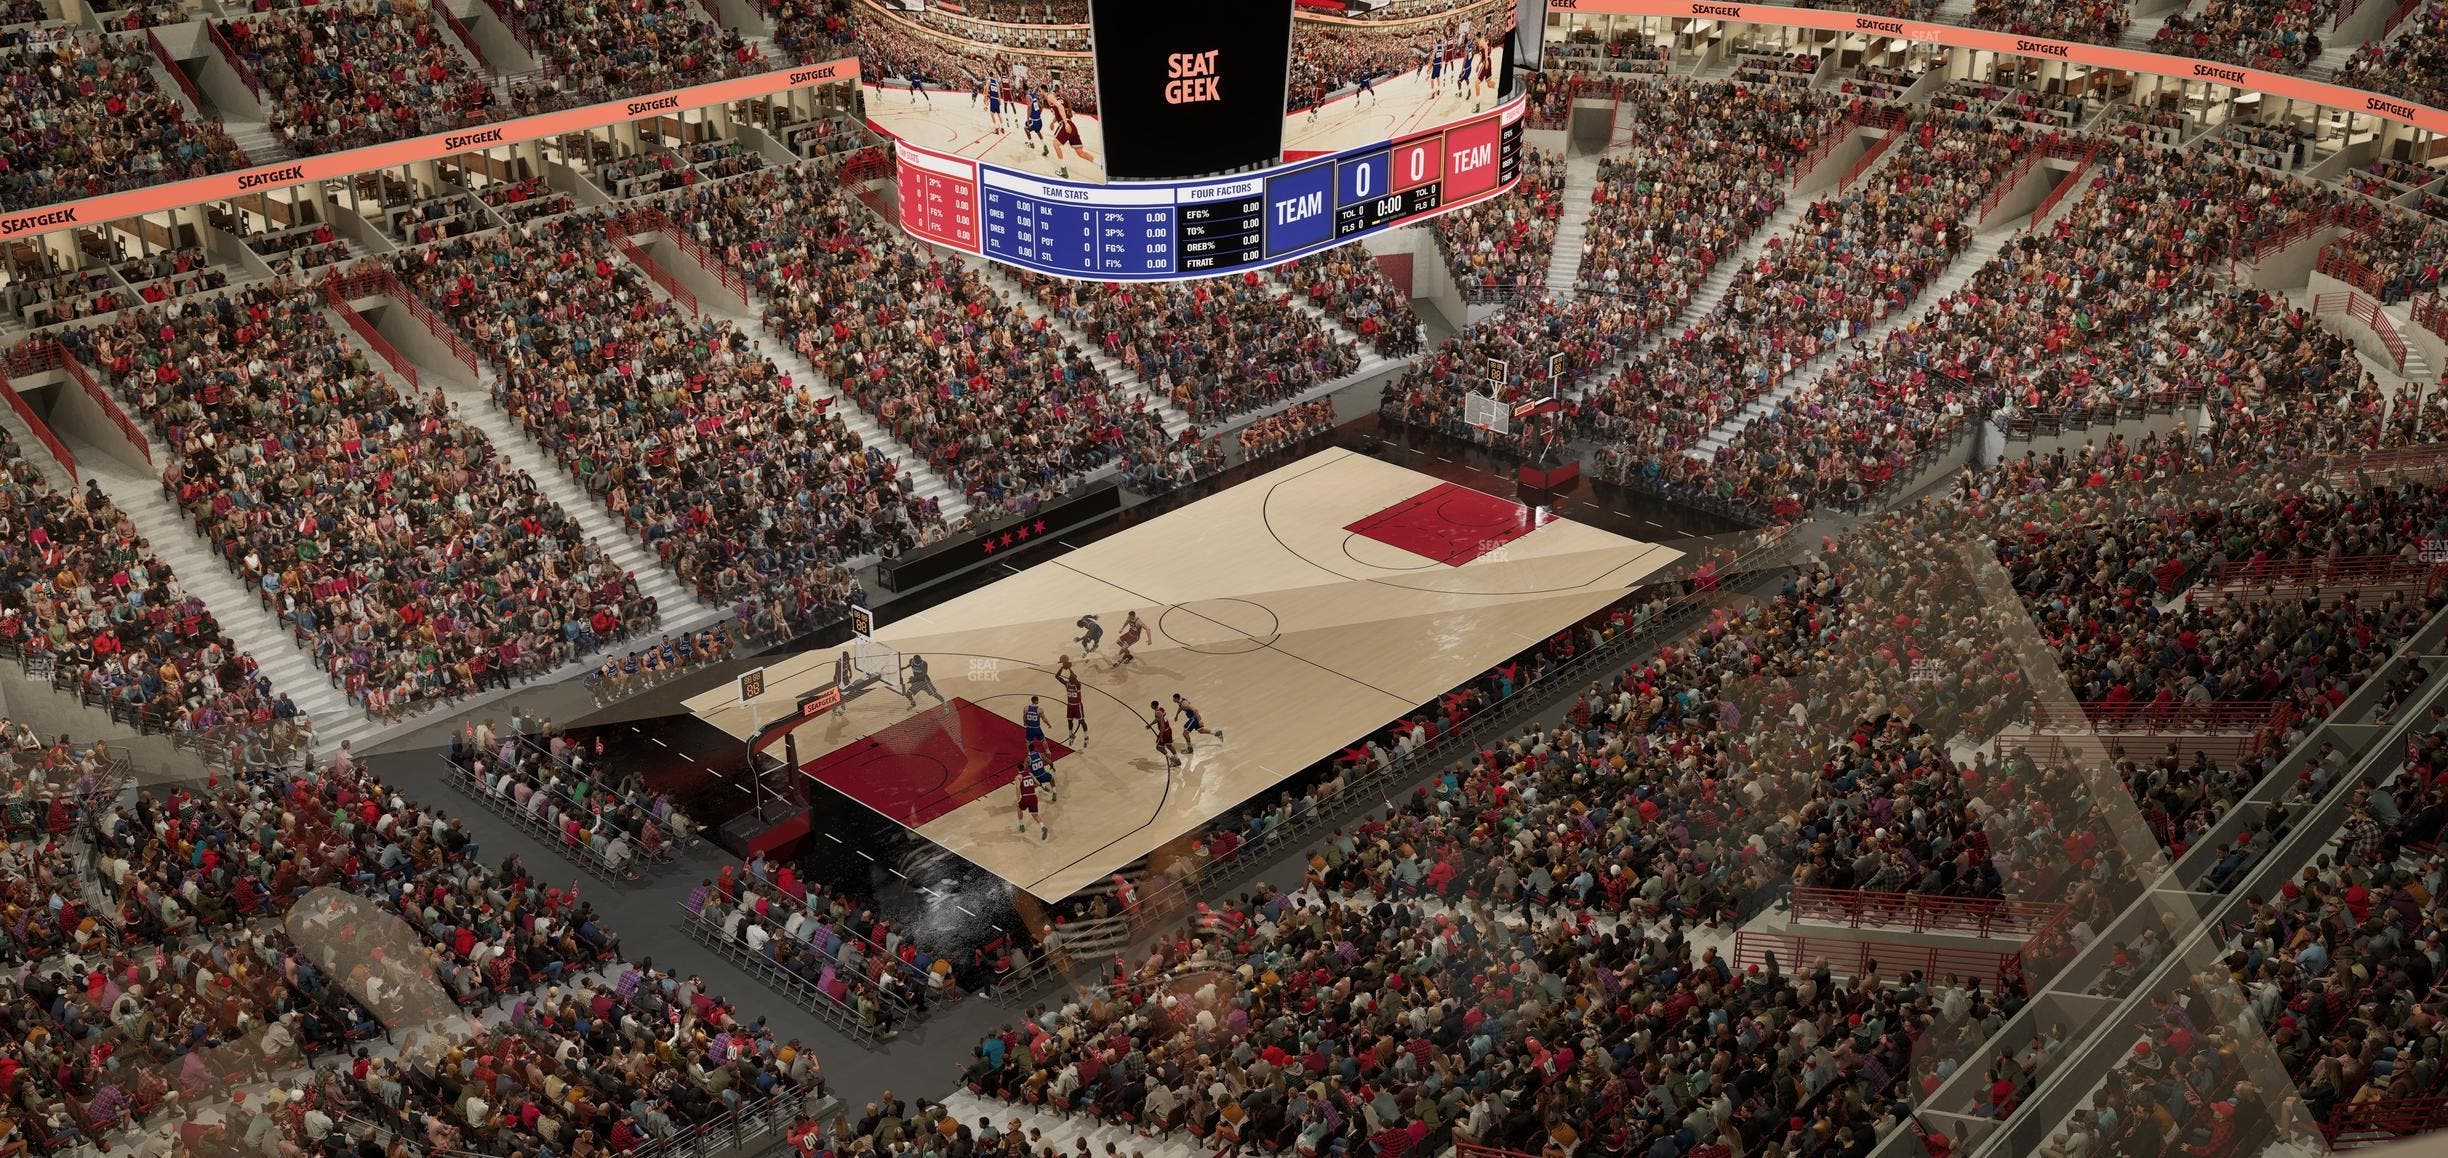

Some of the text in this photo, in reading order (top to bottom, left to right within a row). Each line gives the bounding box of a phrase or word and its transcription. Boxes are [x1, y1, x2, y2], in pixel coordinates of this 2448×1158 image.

[1692, 3, 1741, 18] SEATGEEK
[1856, 18, 1904, 35] SEATGEEK
[2017, 40, 2068, 58] SEATGEEK
[1168, 49, 1219, 79] SEAT
[790, 67, 836, 84] SEATGEEK
[2193, 64, 2246, 84] SEATGEEK
[1165, 76, 1221, 105] GEEK
[627, 95, 679, 116] SEATGEEK
[2366, 97, 2416, 121] SEATGEEK
[445, 128, 503, 151] SEATGEEK
[1411, 147, 1425, 181] 0
[1453, 142, 1492, 175] TEAM
[238, 166, 304, 191] SEATGEEK
[1356, 162, 1371, 197] 0
[954, 184, 969, 196] 0.00
[1042, 186, 1089, 200] TEAM STATS
[1191, 183, 1252, 199] FOUR FACTORS
[1415, 184, 1436, 198] TOL 0
[955, 199, 970, 211] 0.00
[988, 193, 1031, 212] AST 0.00
[1275, 191, 1322, 226] TEAM
[1377, 195, 1402, 217] 0:00
[1415, 201, 1428, 211] FLS
[1040, 206, 1090, 221] BLK 0
[1104, 212, 1167, 223] 2P% 0.00
[1186, 202, 1260, 219] EFG% 0.00
[1341, 205, 1364, 220] TOL 0
[1, 208, 77, 235] SEATGEEK
[956, 214, 970, 226] 0.00
[1017, 215, 1032, 227] 0.00
[1186, 218, 1260, 236] TO% 0.00
[1341, 219, 1364, 234] FLS 0
[957, 229, 971, 240] 0.00
[1017, 231, 1032, 242] 0.00
[1040, 221, 1090, 237] TO 0
[1105, 228, 1167, 238] 3P% 0.00
[990, 238, 1033, 258] STL 0.00
[1041, 237, 1090, 252] POT 0
[1105, 244, 1167, 253] FG% 0.00
[1186, 234, 1260, 252] OREB% 0.00
[1041, 252, 1091, 267] STL 0
[1146, 259, 1167, 269] 0.00
[1186, 250, 1260, 268] FTRATE 0.00
[856, 619, 867, 634] 88
[746, 682, 760, 697] 88
[807, 694, 838, 713] SEATGEEK
[1026, 713, 1038, 722] 00
[1031, 761, 1044, 771] 00
[1023, 778, 1034, 787] 00
[727, 1045, 738, 1060] 00
